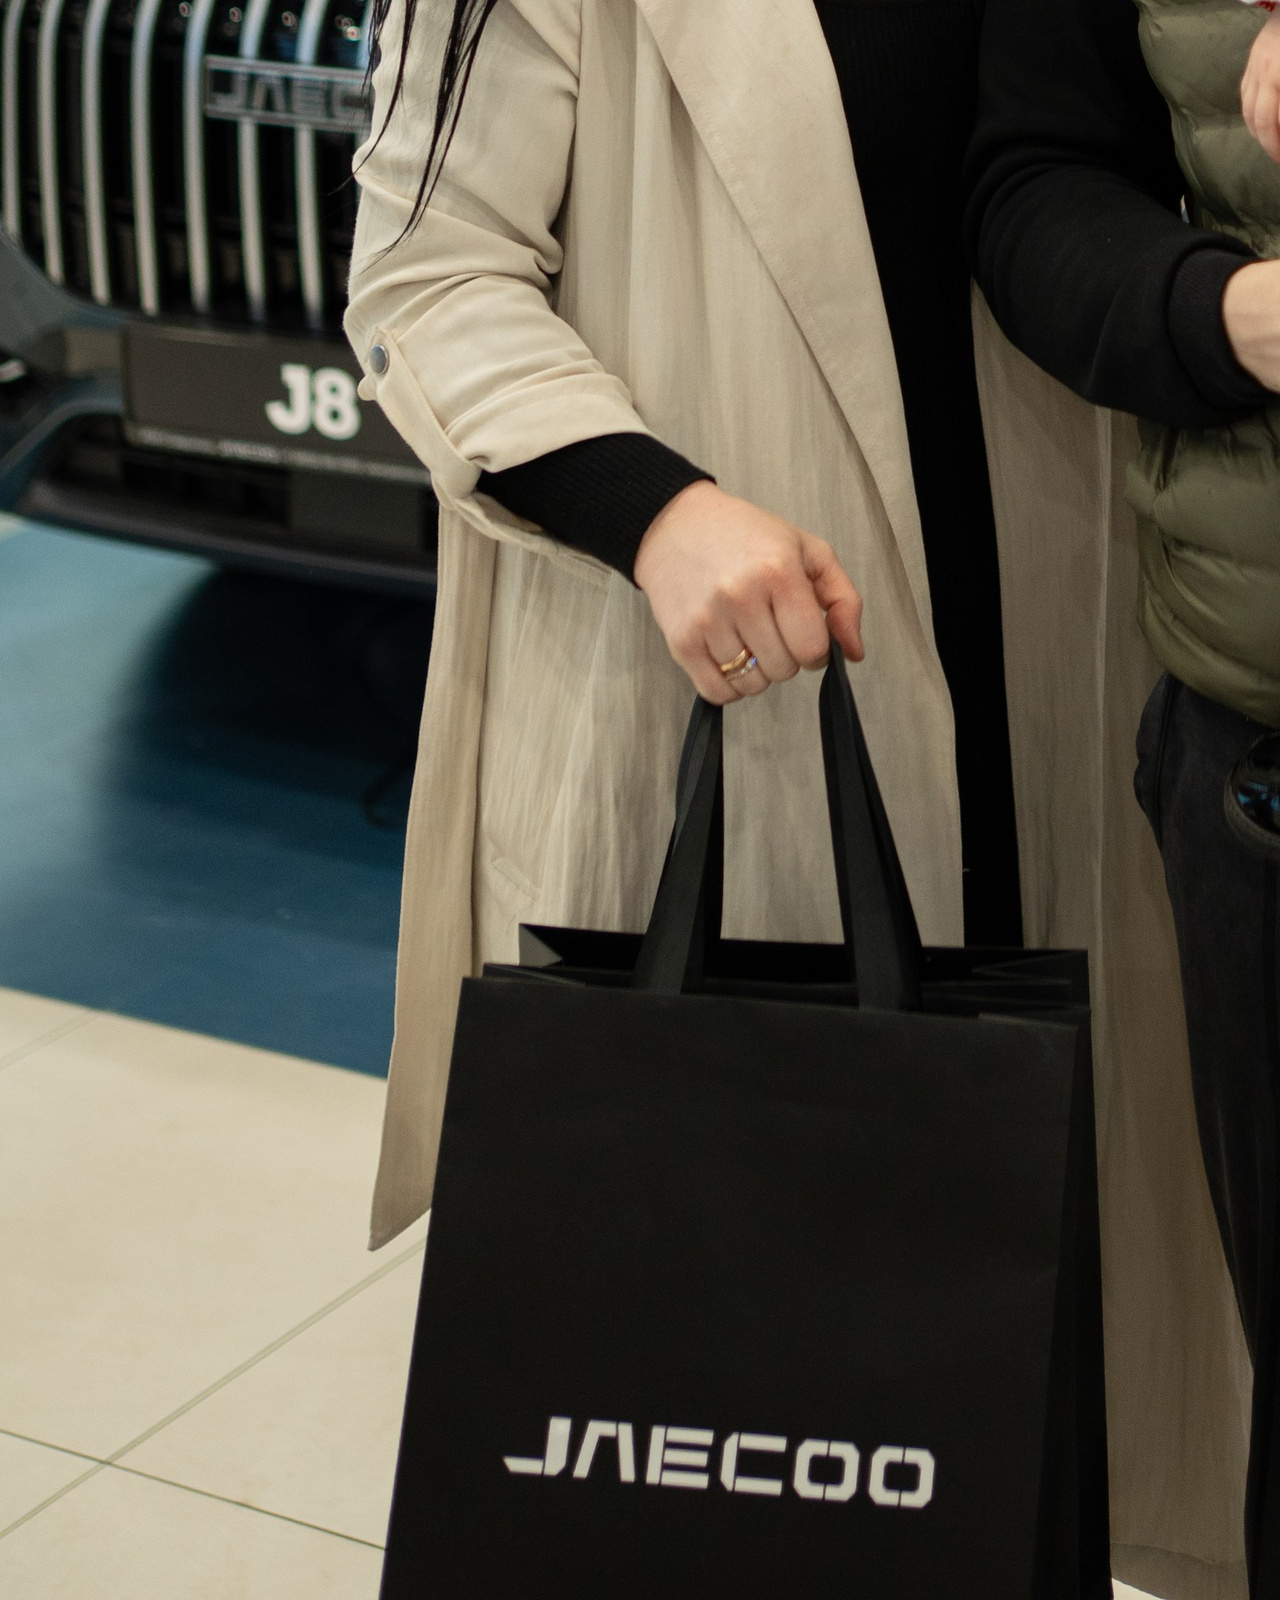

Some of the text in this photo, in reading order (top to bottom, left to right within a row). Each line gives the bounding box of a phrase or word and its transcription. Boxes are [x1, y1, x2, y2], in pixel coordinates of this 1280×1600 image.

[206, 70, 374, 121] JAEC
[264, 362, 361, 441] J8
[503, 1415, 935, 1508] JAECOO
